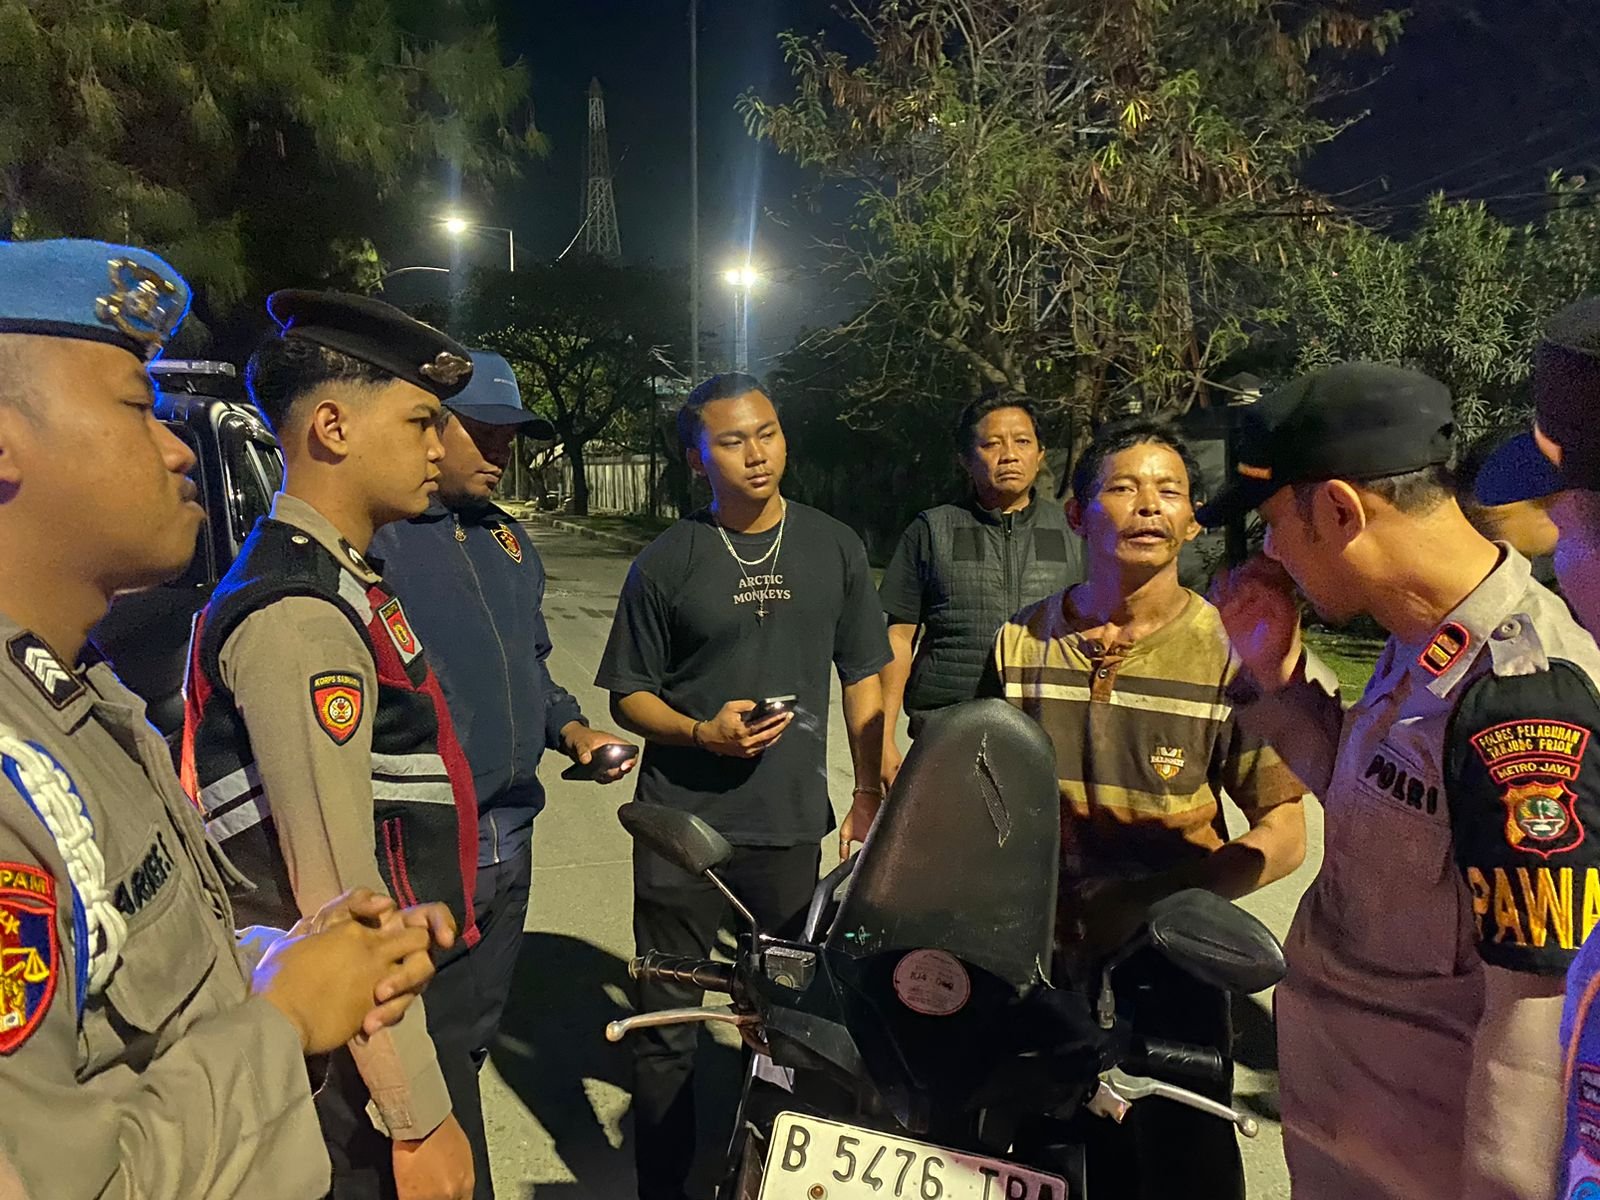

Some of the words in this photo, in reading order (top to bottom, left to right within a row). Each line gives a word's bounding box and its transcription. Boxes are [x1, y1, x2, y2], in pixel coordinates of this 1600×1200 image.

[739, 574, 783, 588] ARCTIC
[733, 589, 791, 604] MONKEYS
[1479, 727, 1514, 748] POLRES
[1517, 724, 1581, 744] PELABUHAN
[1365, 755, 1438, 815] POLRI
[781, 1124, 811, 1173] B
[832, 1134, 945, 1200] 5476
